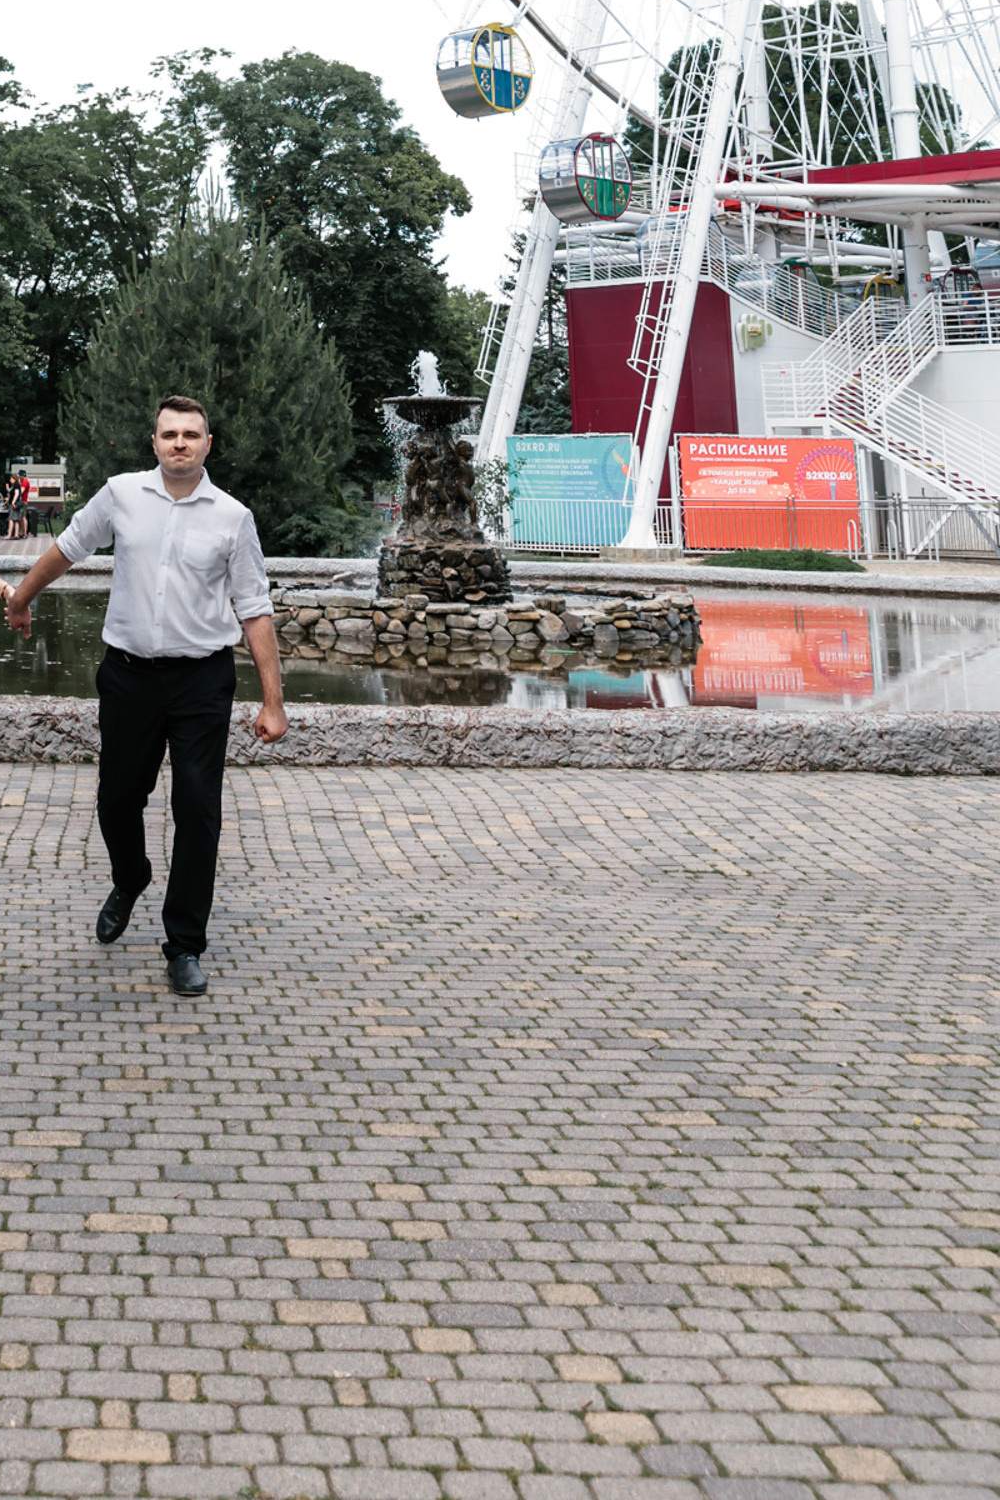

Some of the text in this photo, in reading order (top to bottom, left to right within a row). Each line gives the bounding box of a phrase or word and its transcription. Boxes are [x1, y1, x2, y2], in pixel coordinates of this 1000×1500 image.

[515, 442, 560, 452] 52KRD.RU
[689, 443, 788, 456] РАСПИСАНИЕ
[805, 471, 853, 481] 52KRD.RU
